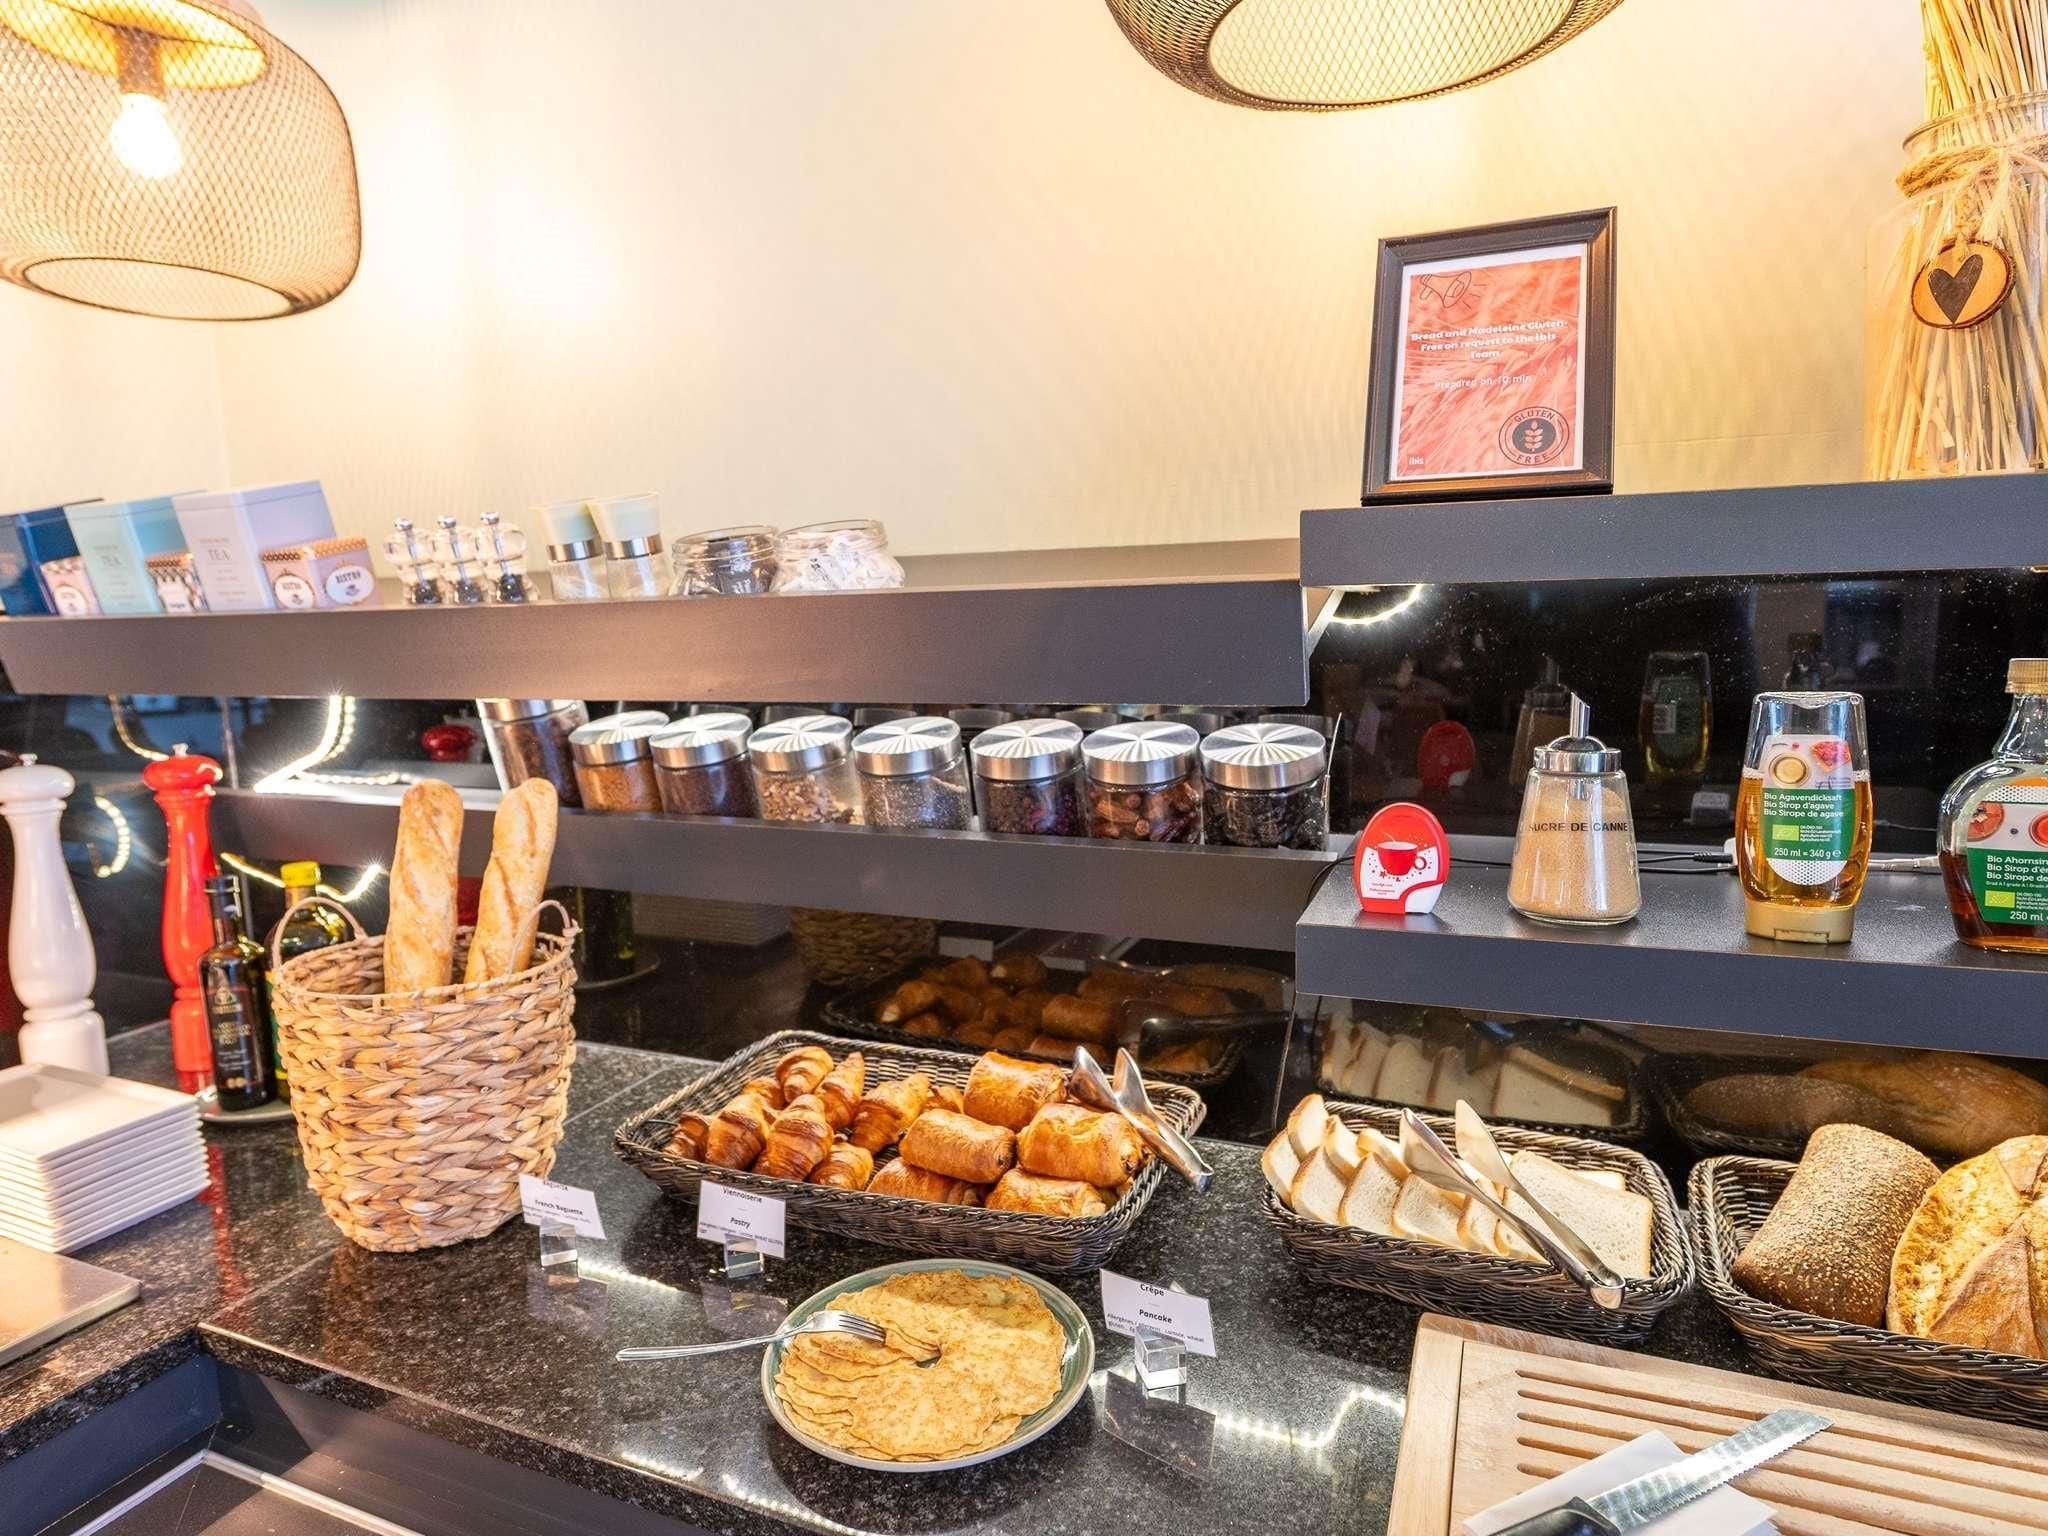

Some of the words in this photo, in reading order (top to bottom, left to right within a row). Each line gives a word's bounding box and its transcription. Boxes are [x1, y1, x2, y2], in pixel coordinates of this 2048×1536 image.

[1411, 332, 1445, 341] Bread
[1445, 329, 1467, 338] and
[1468, 324, 1526, 335] Madeleine
[1420, 343, 1443, 352] Free
[1460, 339, 1501, 350] request
[1502, 337, 1513, 345] to
[1515, 334, 1533, 343] the
[1434, 378, 1477, 391] Prepared
[1480, 376, 1493, 385] on
[1513, 409, 1556, 423] GLUTEN
[1516, 453, 1550, 464] FREE
[1779, 793, 1842, 802] Agavendicksaft
[1763, 800, 1778, 808] Bio
[1779, 801, 1801, 809] Sirop
[1803, 802, 1835, 810] d'agave
[1779, 809, 1806, 817] Sirope
[1529, 822, 1566, 832] SUCRE
[1570, 822, 1589, 832] DE
[1592, 822, 1630, 832] CANNE
[1774, 847, 1789, 857] 250
[1790, 848, 1801, 857] ml
[1809, 849, 1825, 858] 340
[1826, 850, 1831, 859] g
[1986, 855, 2003, 863] Bio
[1986, 863, 2002, 871] Bio
[2004, 865, 2029, 873] Sirop
[1986, 871, 2002, 879] Bio
[2004, 873, 2035, 882] Sirope
[2009, 911, 2028, 920] 250
[2030, 912, 2044, 921] ml
[722, 1187, 763, 1203] Viennoiserie
[534, 1199, 555, 1210] French
[555, 1204, 584, 1215] Baguette
[729, 1216, 751, 1229] Pastry
[1139, 1308, 1173, 1325] Pancake
